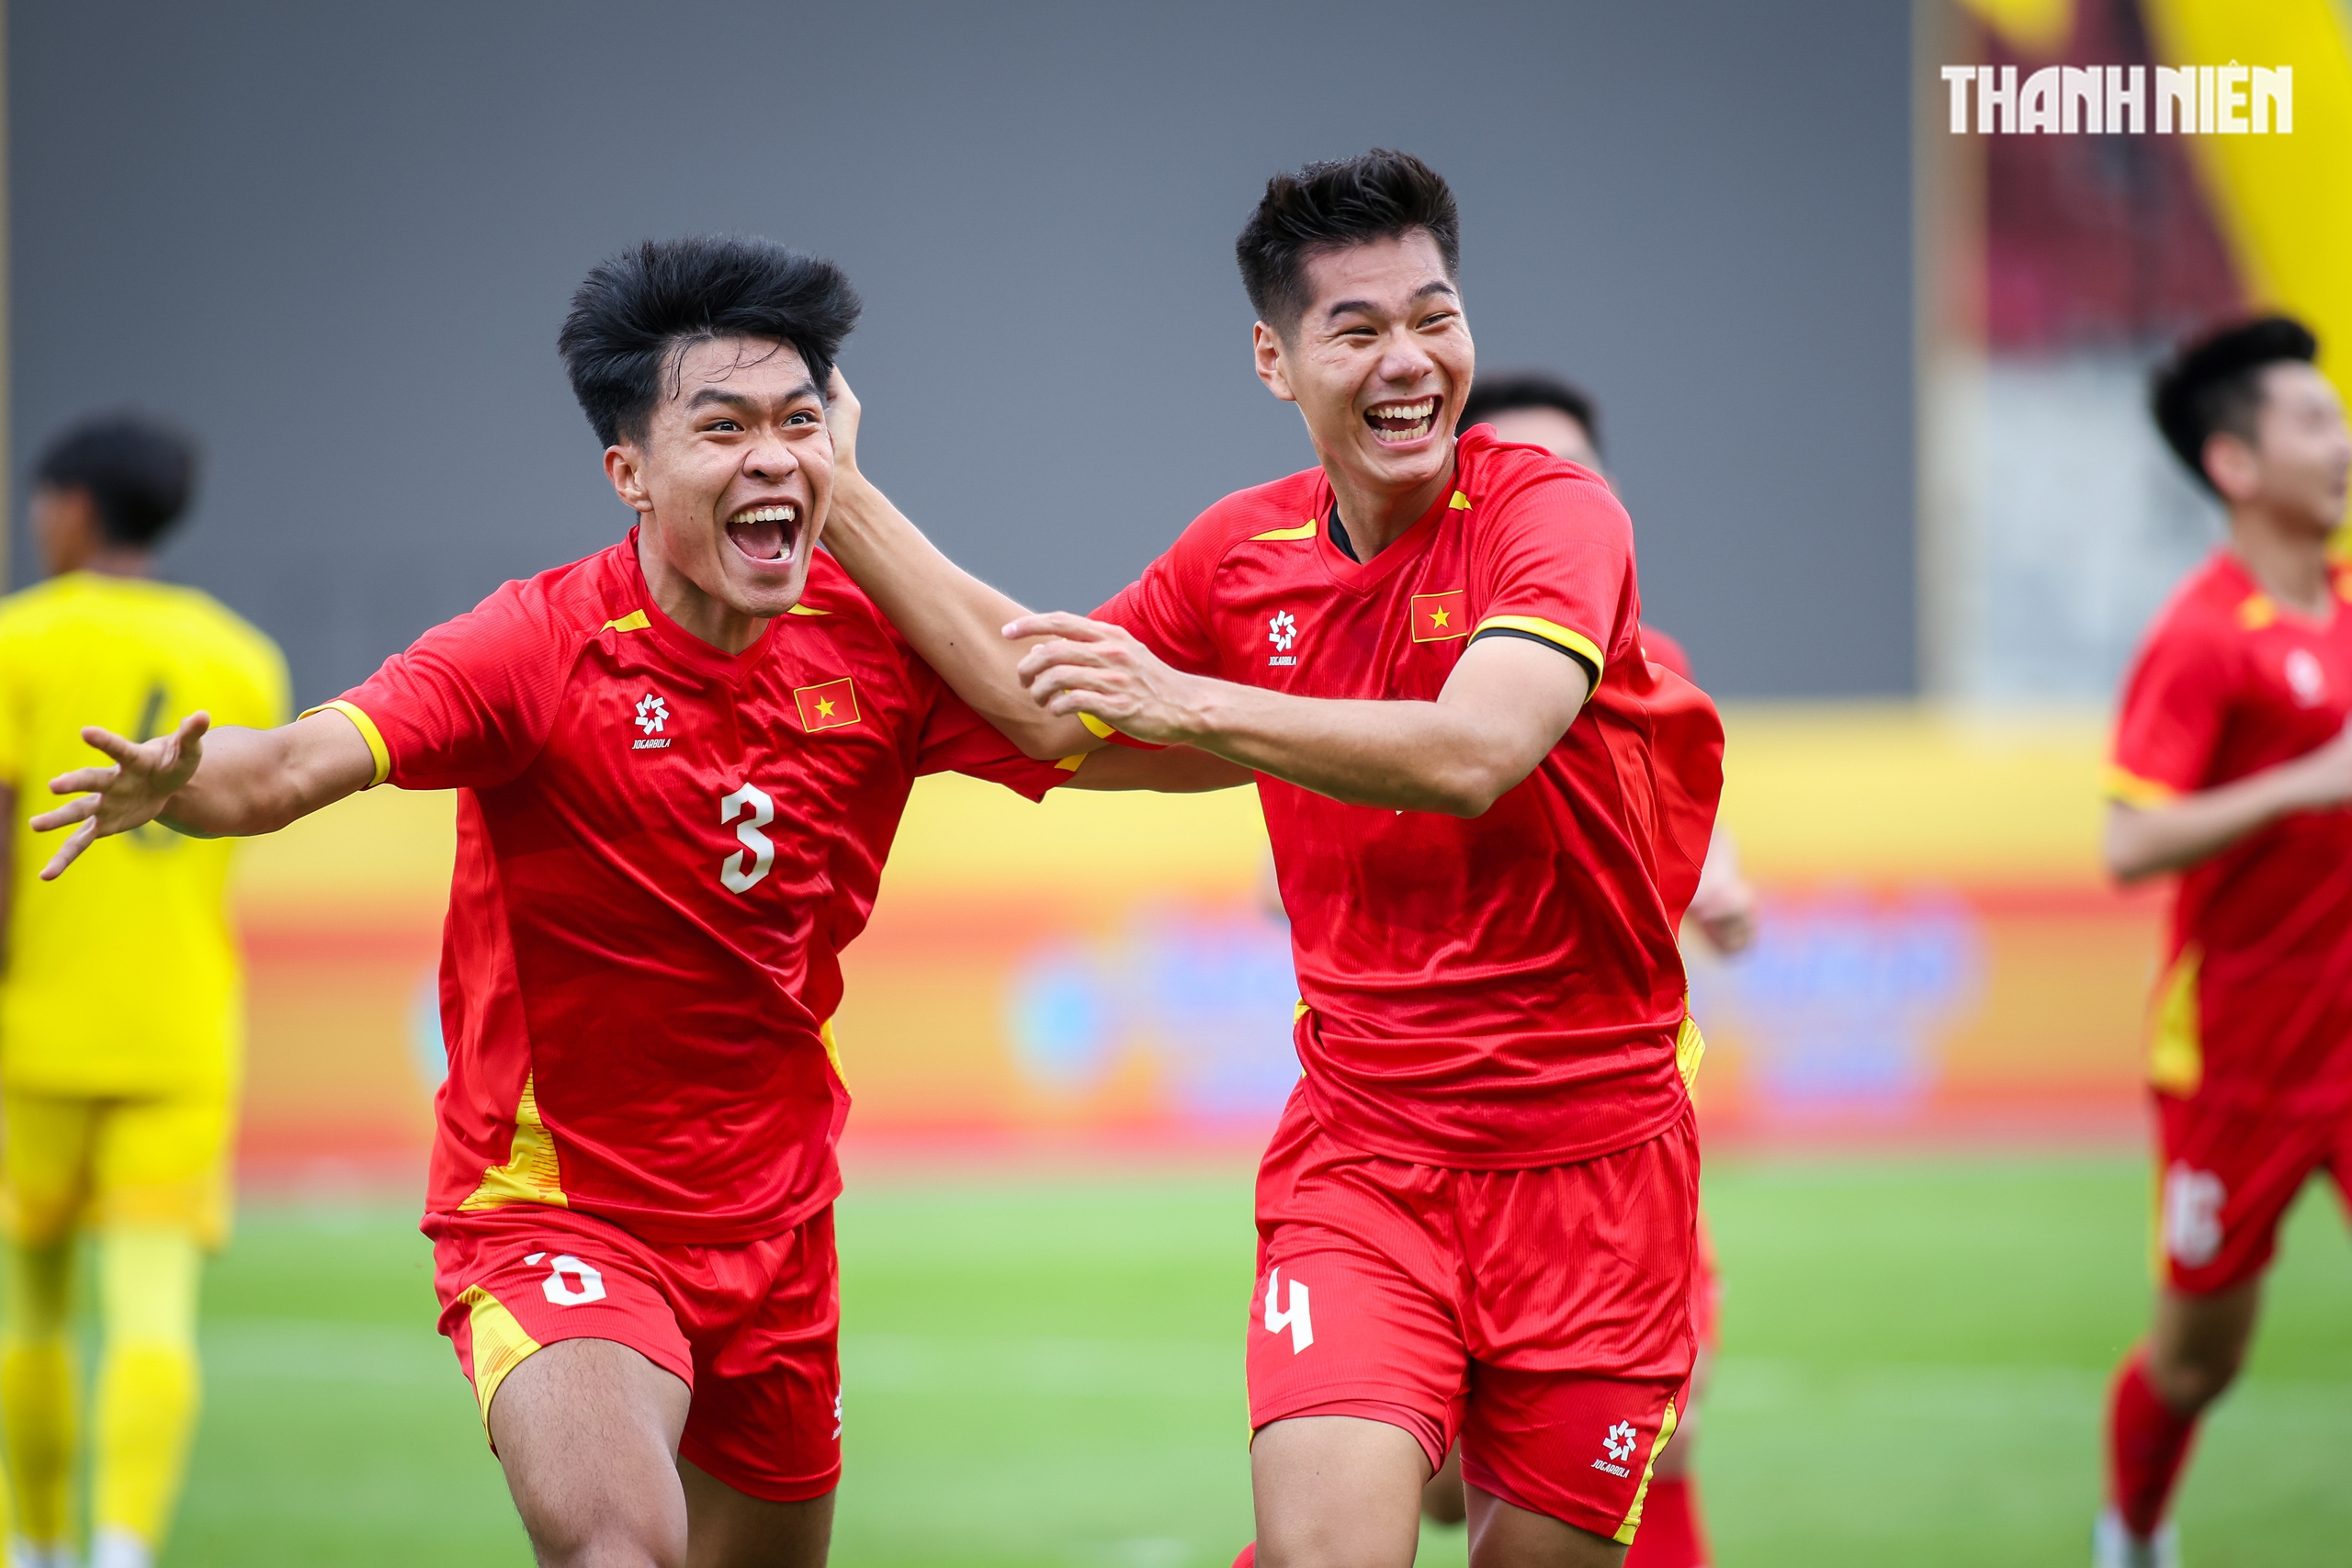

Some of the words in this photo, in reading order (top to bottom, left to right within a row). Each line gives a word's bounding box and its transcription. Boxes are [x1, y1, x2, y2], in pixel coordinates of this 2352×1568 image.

[631, 738, 672, 750] JOGARBOLA
[719, 782, 775, 895] 3
[1264, 1266, 1314, 1356] 4
[1590, 1458, 1631, 1479] JOGARBOLA
